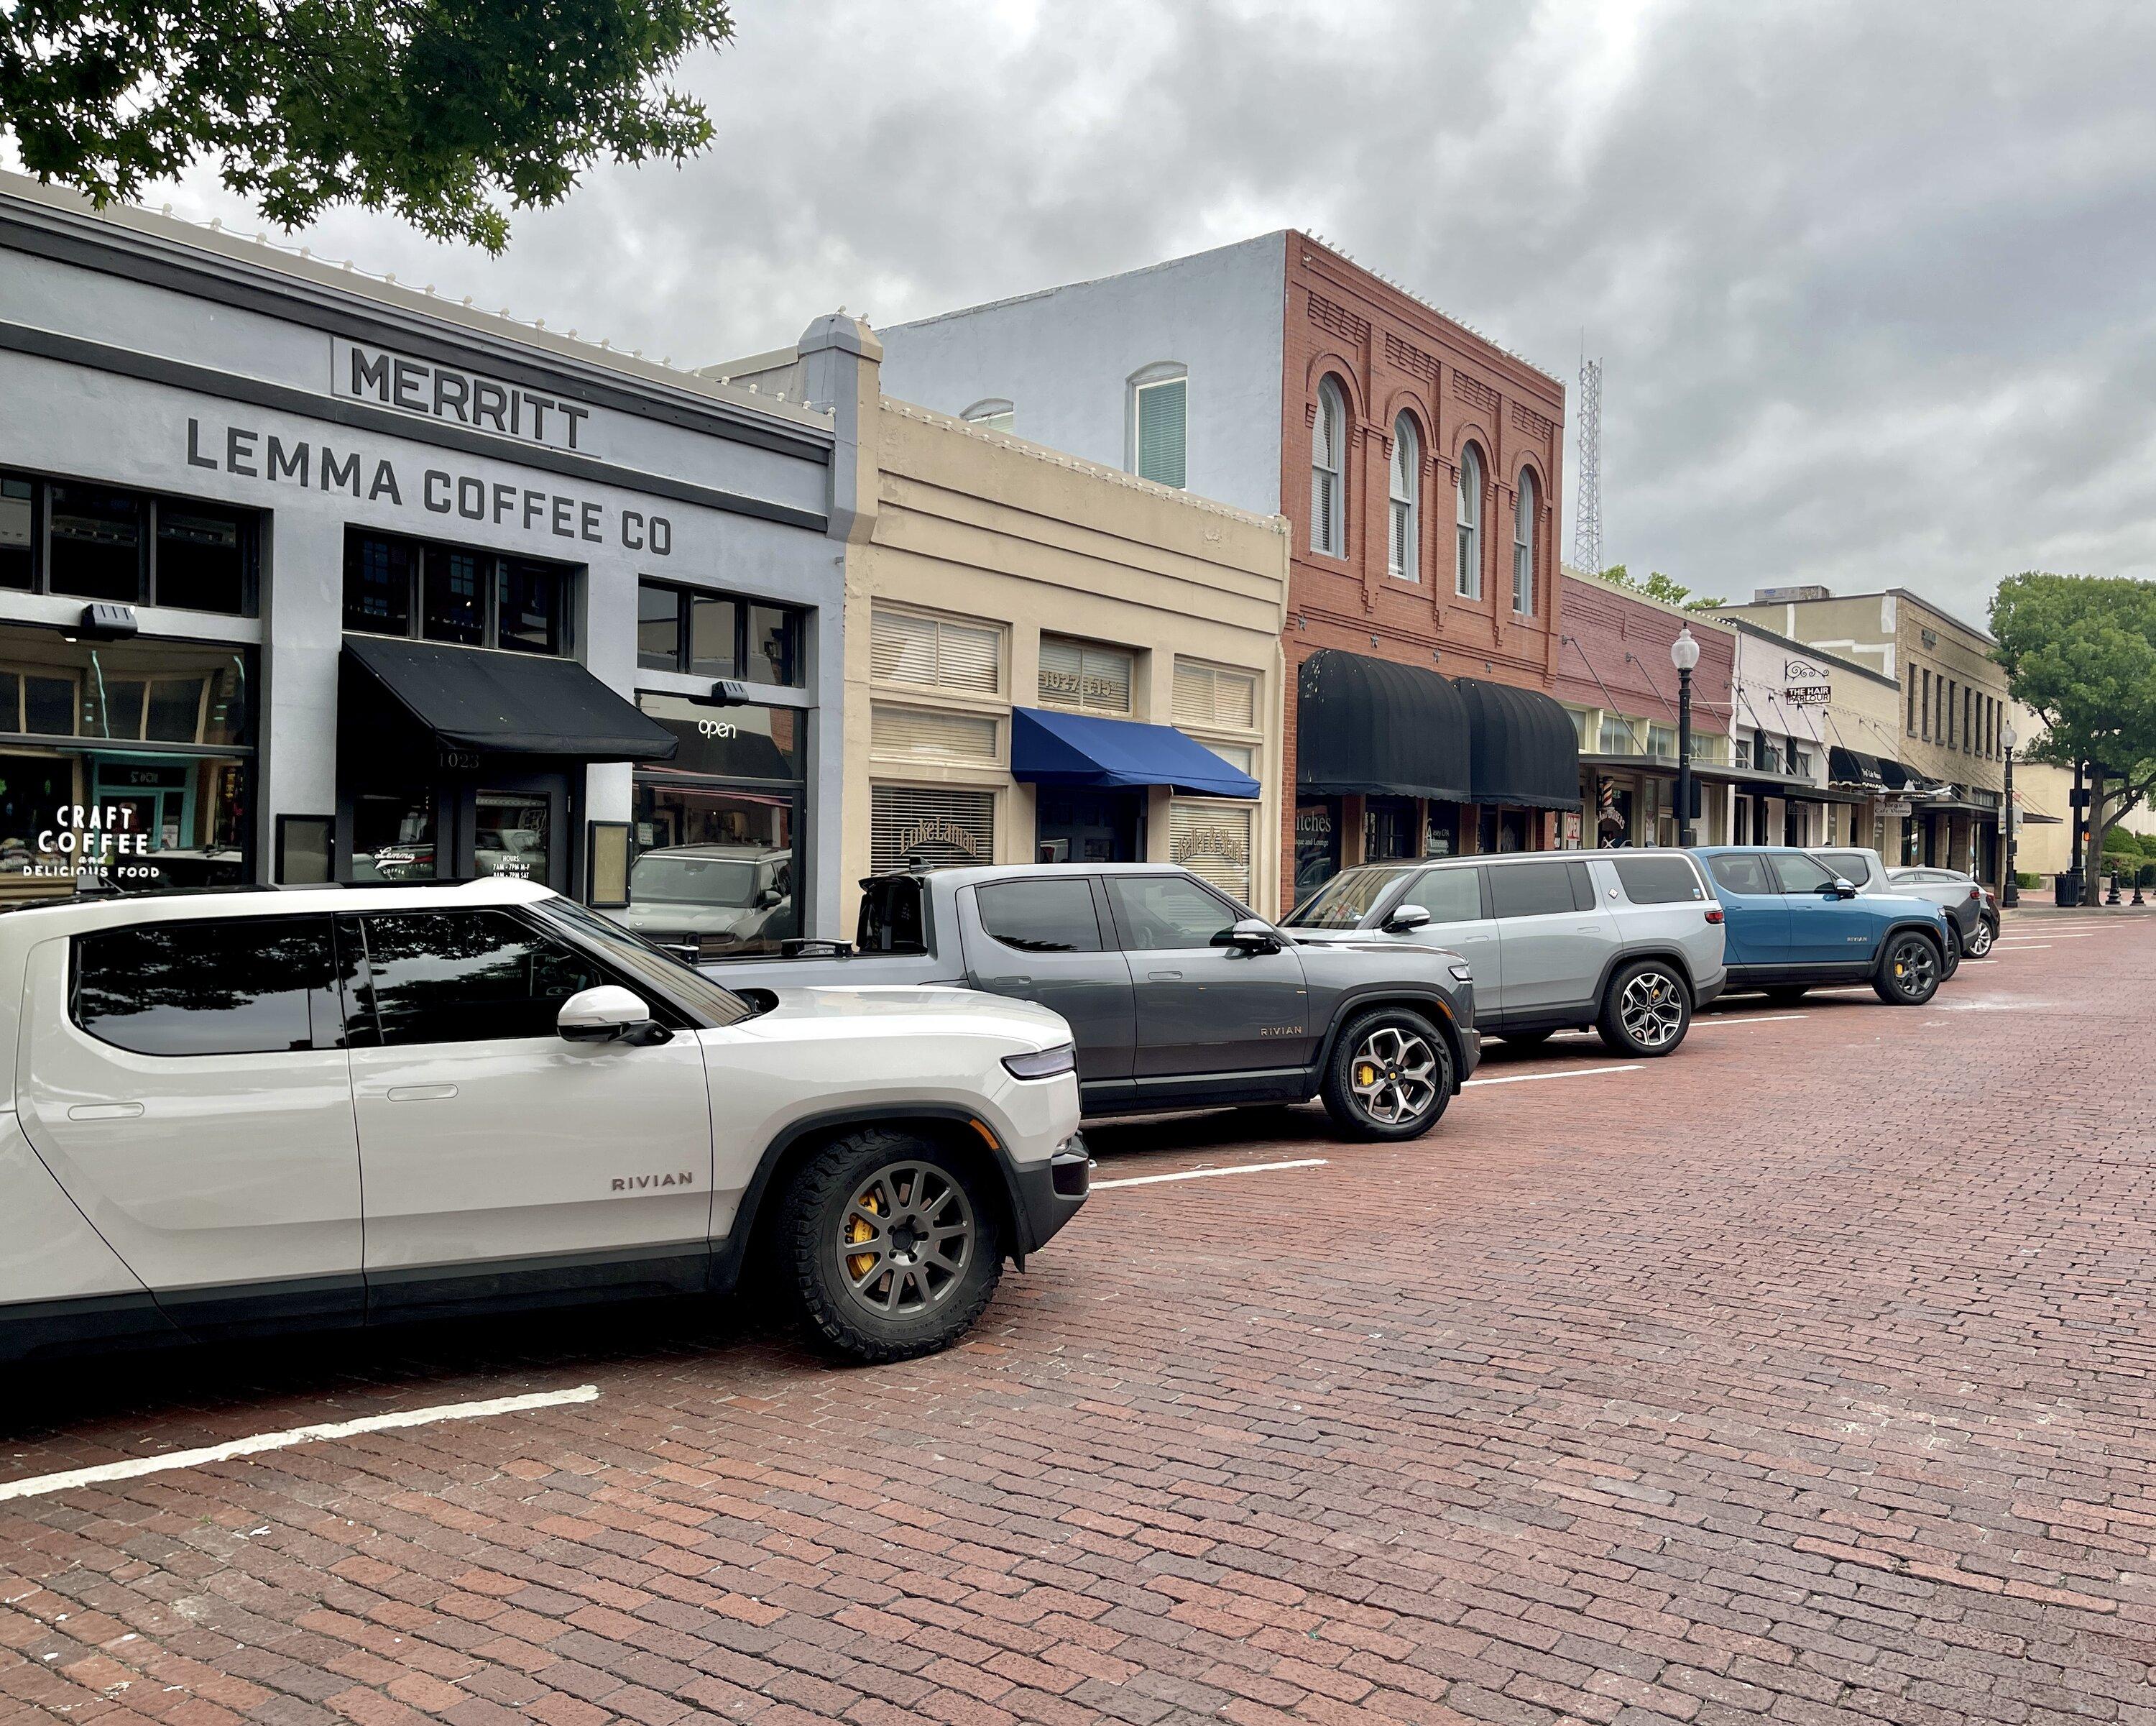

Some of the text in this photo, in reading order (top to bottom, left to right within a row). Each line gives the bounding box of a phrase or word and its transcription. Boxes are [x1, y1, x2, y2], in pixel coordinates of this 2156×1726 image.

[352, 347, 589, 449] MERRITT
[188, 418, 671, 556] LEMMA COFFEE CO
[1807, 687, 1829, 696] HAIR
[698, 719, 736, 739] open
[440, 752, 479, 768] 1023
[56, 805, 132, 830] CRAFT
[37, 830, 148, 855] COFFEE
[78, 853, 108, 864] and
[23, 866, 160, 878] DELICIOUS FOOD
[1261, 1025, 1302, 1036] RIVIAN
[611, 1171, 693, 1190] RIVIAN
